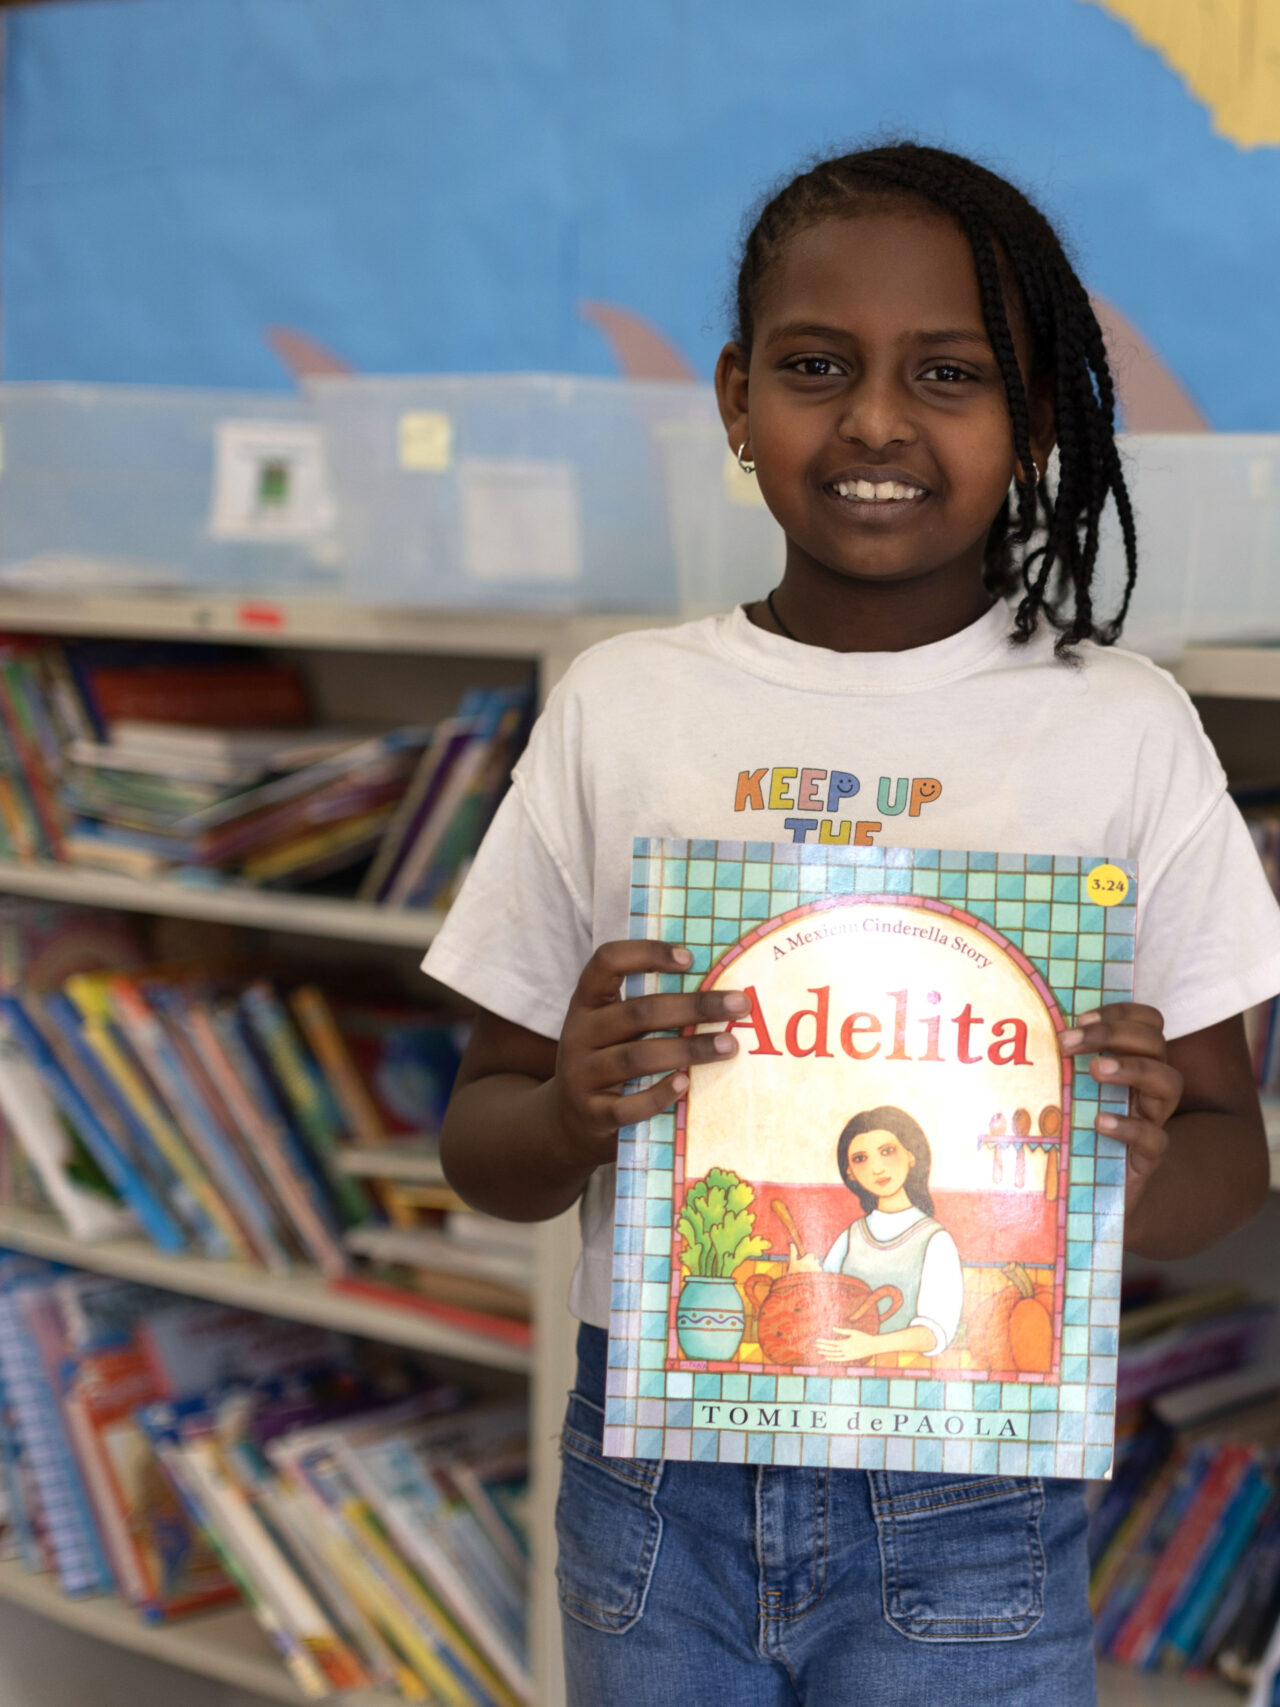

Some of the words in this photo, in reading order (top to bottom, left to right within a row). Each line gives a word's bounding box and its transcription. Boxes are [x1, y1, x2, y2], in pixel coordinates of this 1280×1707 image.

[734, 767, 861, 812] KEEP
[877, 776, 942, 817] UP
[784, 818, 882, 846] THE
[1091, 877, 1125, 894] 3.24
[772, 945, 787, 960] A
[787, 920, 859, 950] Mexican
[862, 918, 948, 946] Cinderella
[950, 936, 993, 970] Story
[726, 985, 1034, 1066] Adelita
[702, 1405, 829, 1430] TOMIE
